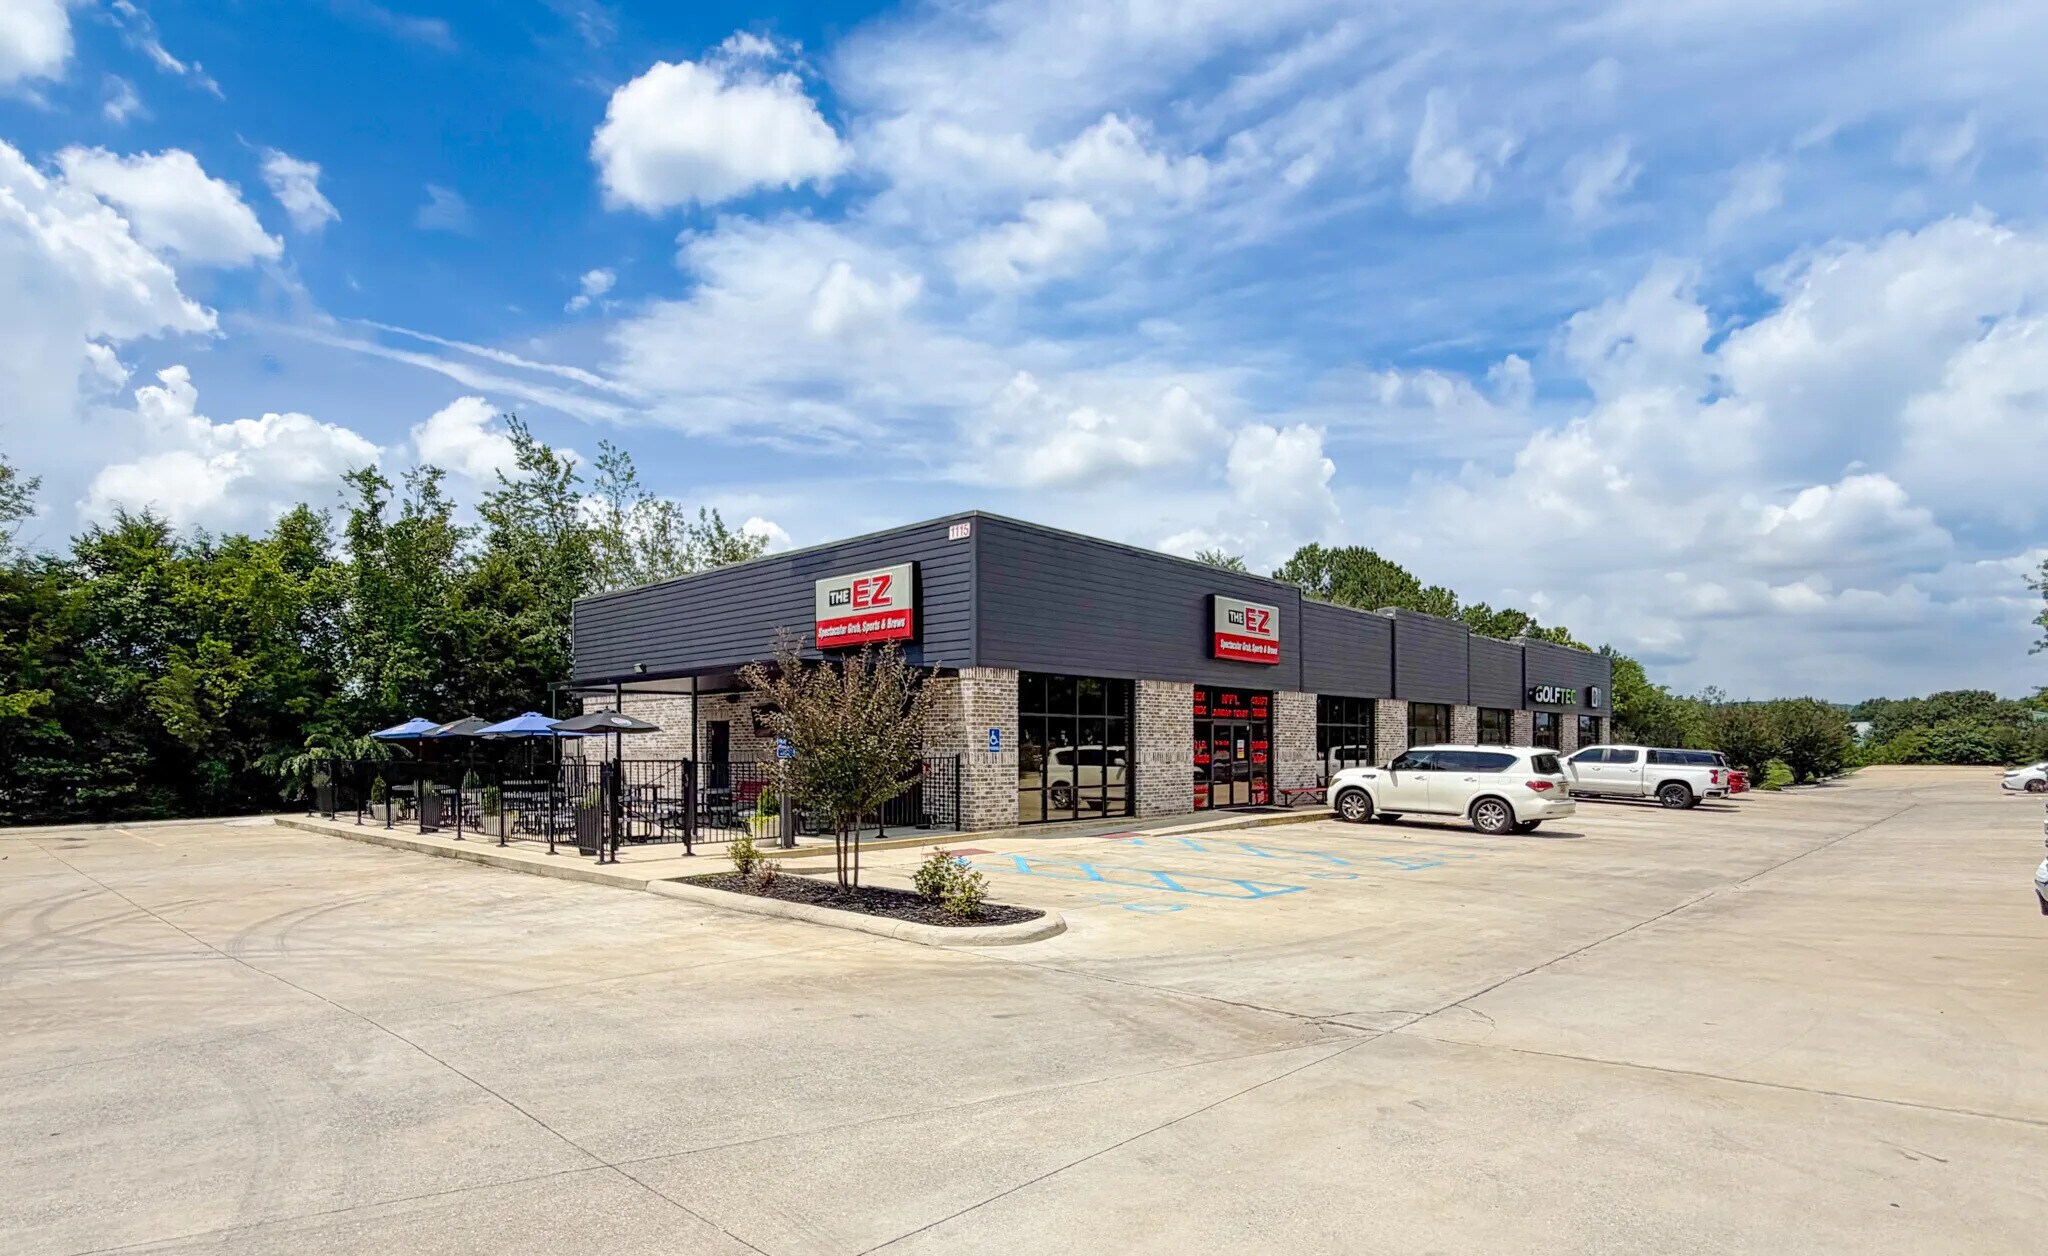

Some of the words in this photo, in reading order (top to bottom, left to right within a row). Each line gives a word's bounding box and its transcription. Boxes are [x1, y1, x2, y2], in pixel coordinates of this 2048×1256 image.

[951, 524, 969, 537] 1115
[829, 589, 850, 605] THE
[852, 573, 892, 610] EZ
[862, 620, 881, 633] Sports
[881, 619, 886, 629] &
[887, 617, 906, 628] Brews
[1229, 611, 1244, 624] THE
[1245, 607, 1270, 635] EZ
[1222, 694, 1240, 705] NFL
[1535, 686, 1577, 704] GOLFTEC
